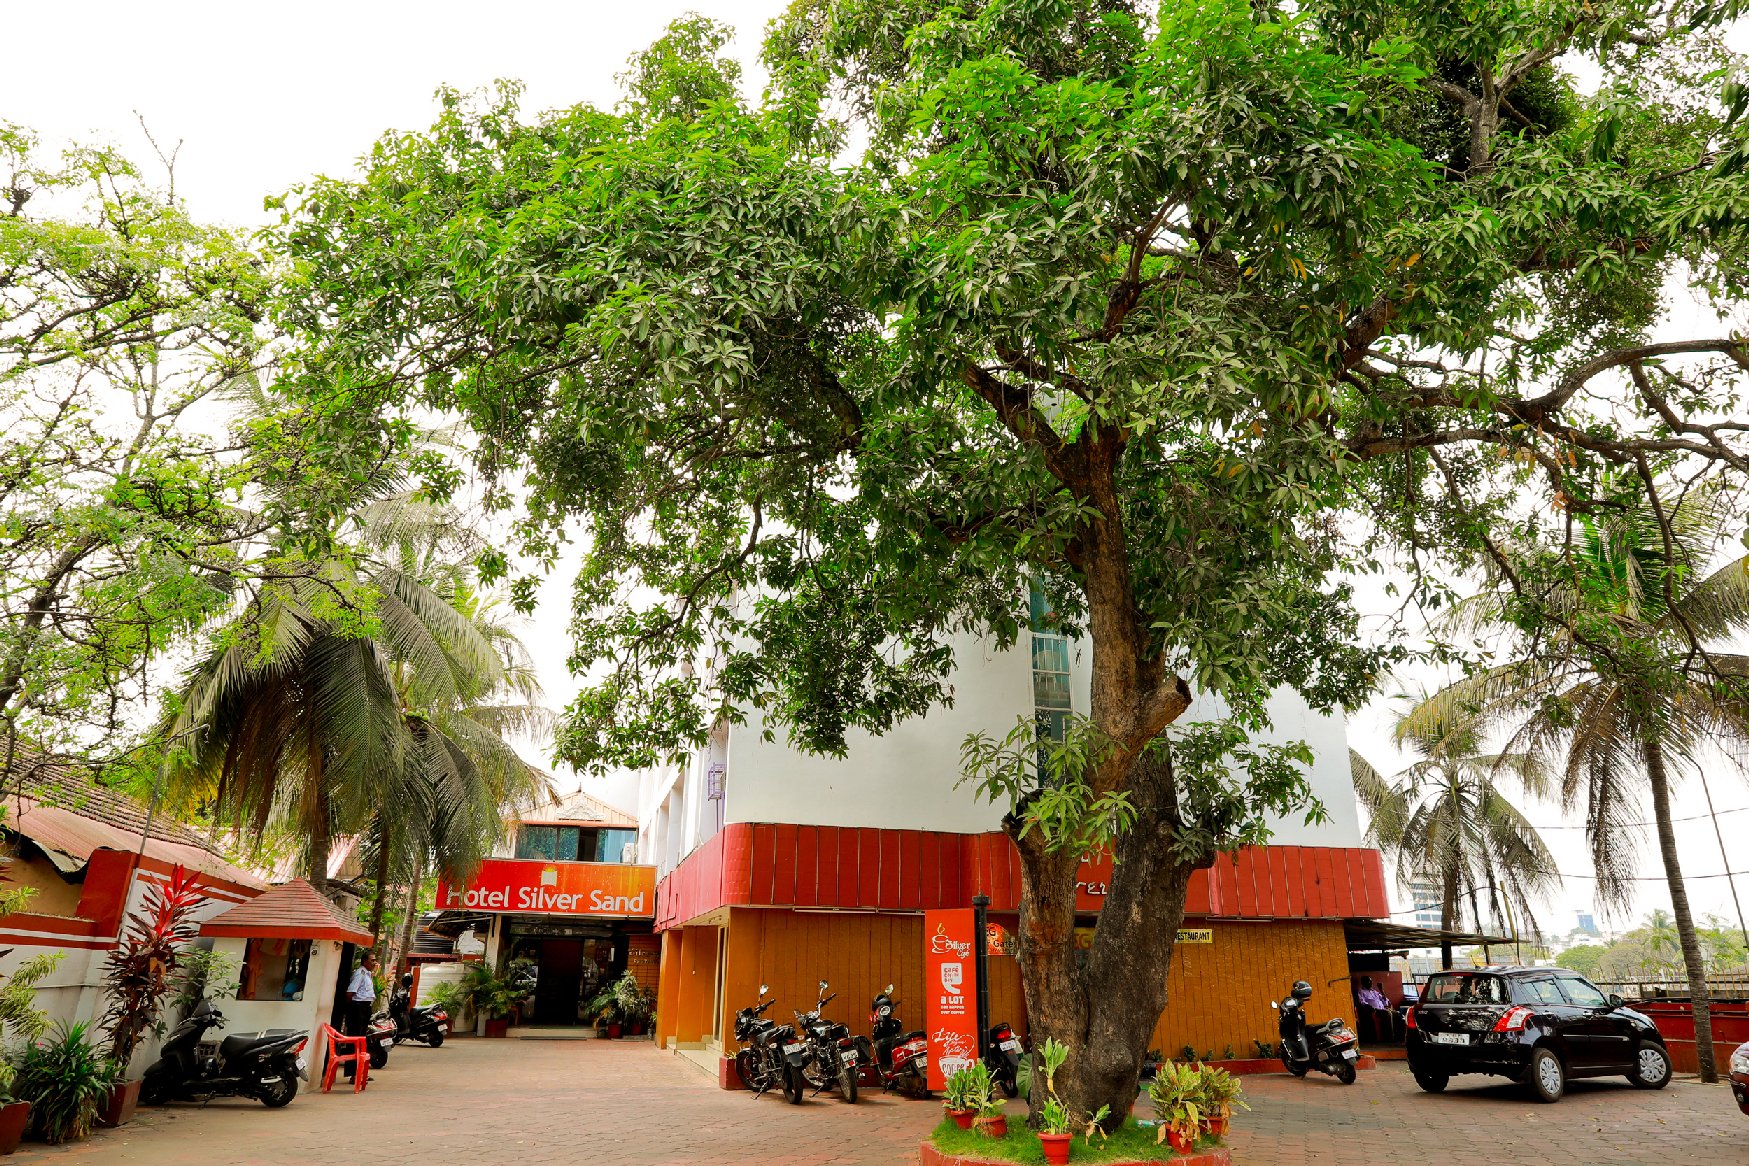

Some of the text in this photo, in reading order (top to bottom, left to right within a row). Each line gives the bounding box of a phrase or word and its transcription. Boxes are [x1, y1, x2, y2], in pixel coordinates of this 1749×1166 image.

[446, 884, 644, 913] Hotel Silver Sand
